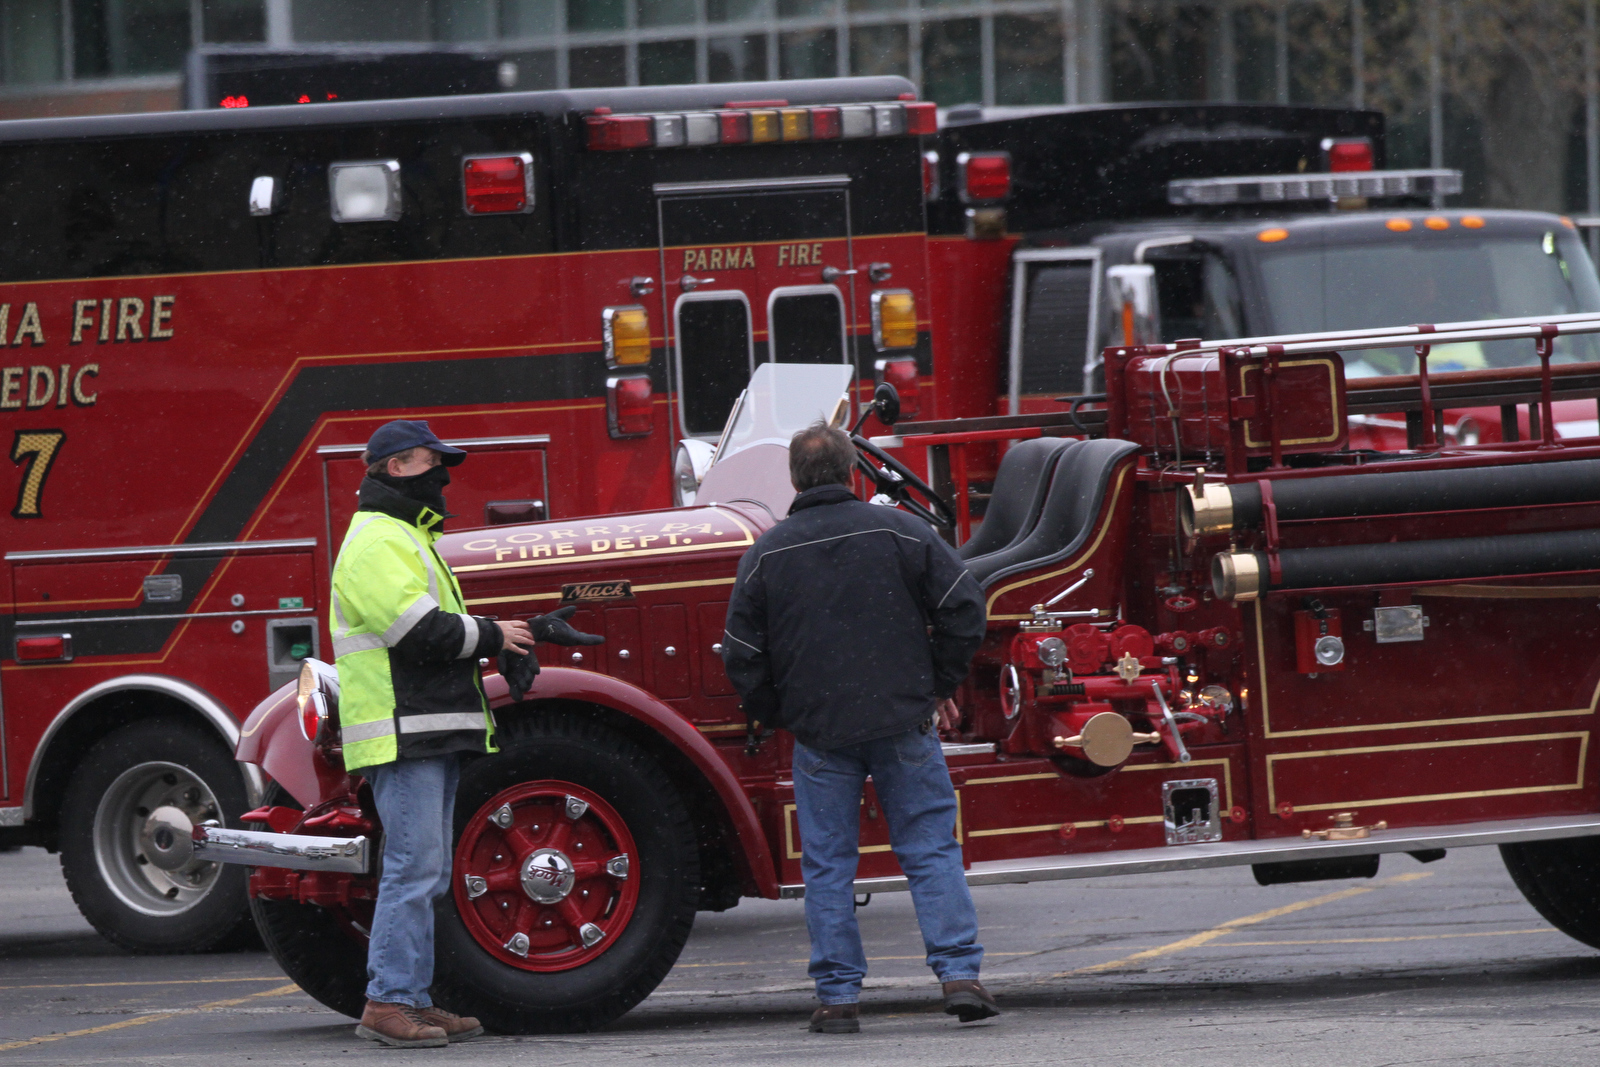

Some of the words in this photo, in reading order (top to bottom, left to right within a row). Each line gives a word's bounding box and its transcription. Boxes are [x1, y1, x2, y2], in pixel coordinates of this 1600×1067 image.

[683, 247, 756, 272] PARMA
[777, 243, 824, 267] FIRE
[70, 295, 176, 345] FIRE
[0, 363, 100, 411] EDIC
[10, 429, 67, 519] 7
[659, 522, 724, 536] PA.
[495, 541, 576, 562] FIRE
[590, 532, 693, 553] DEPT.
[566, 582, 626, 600] Mack
[528, 865, 568, 888] Mack
